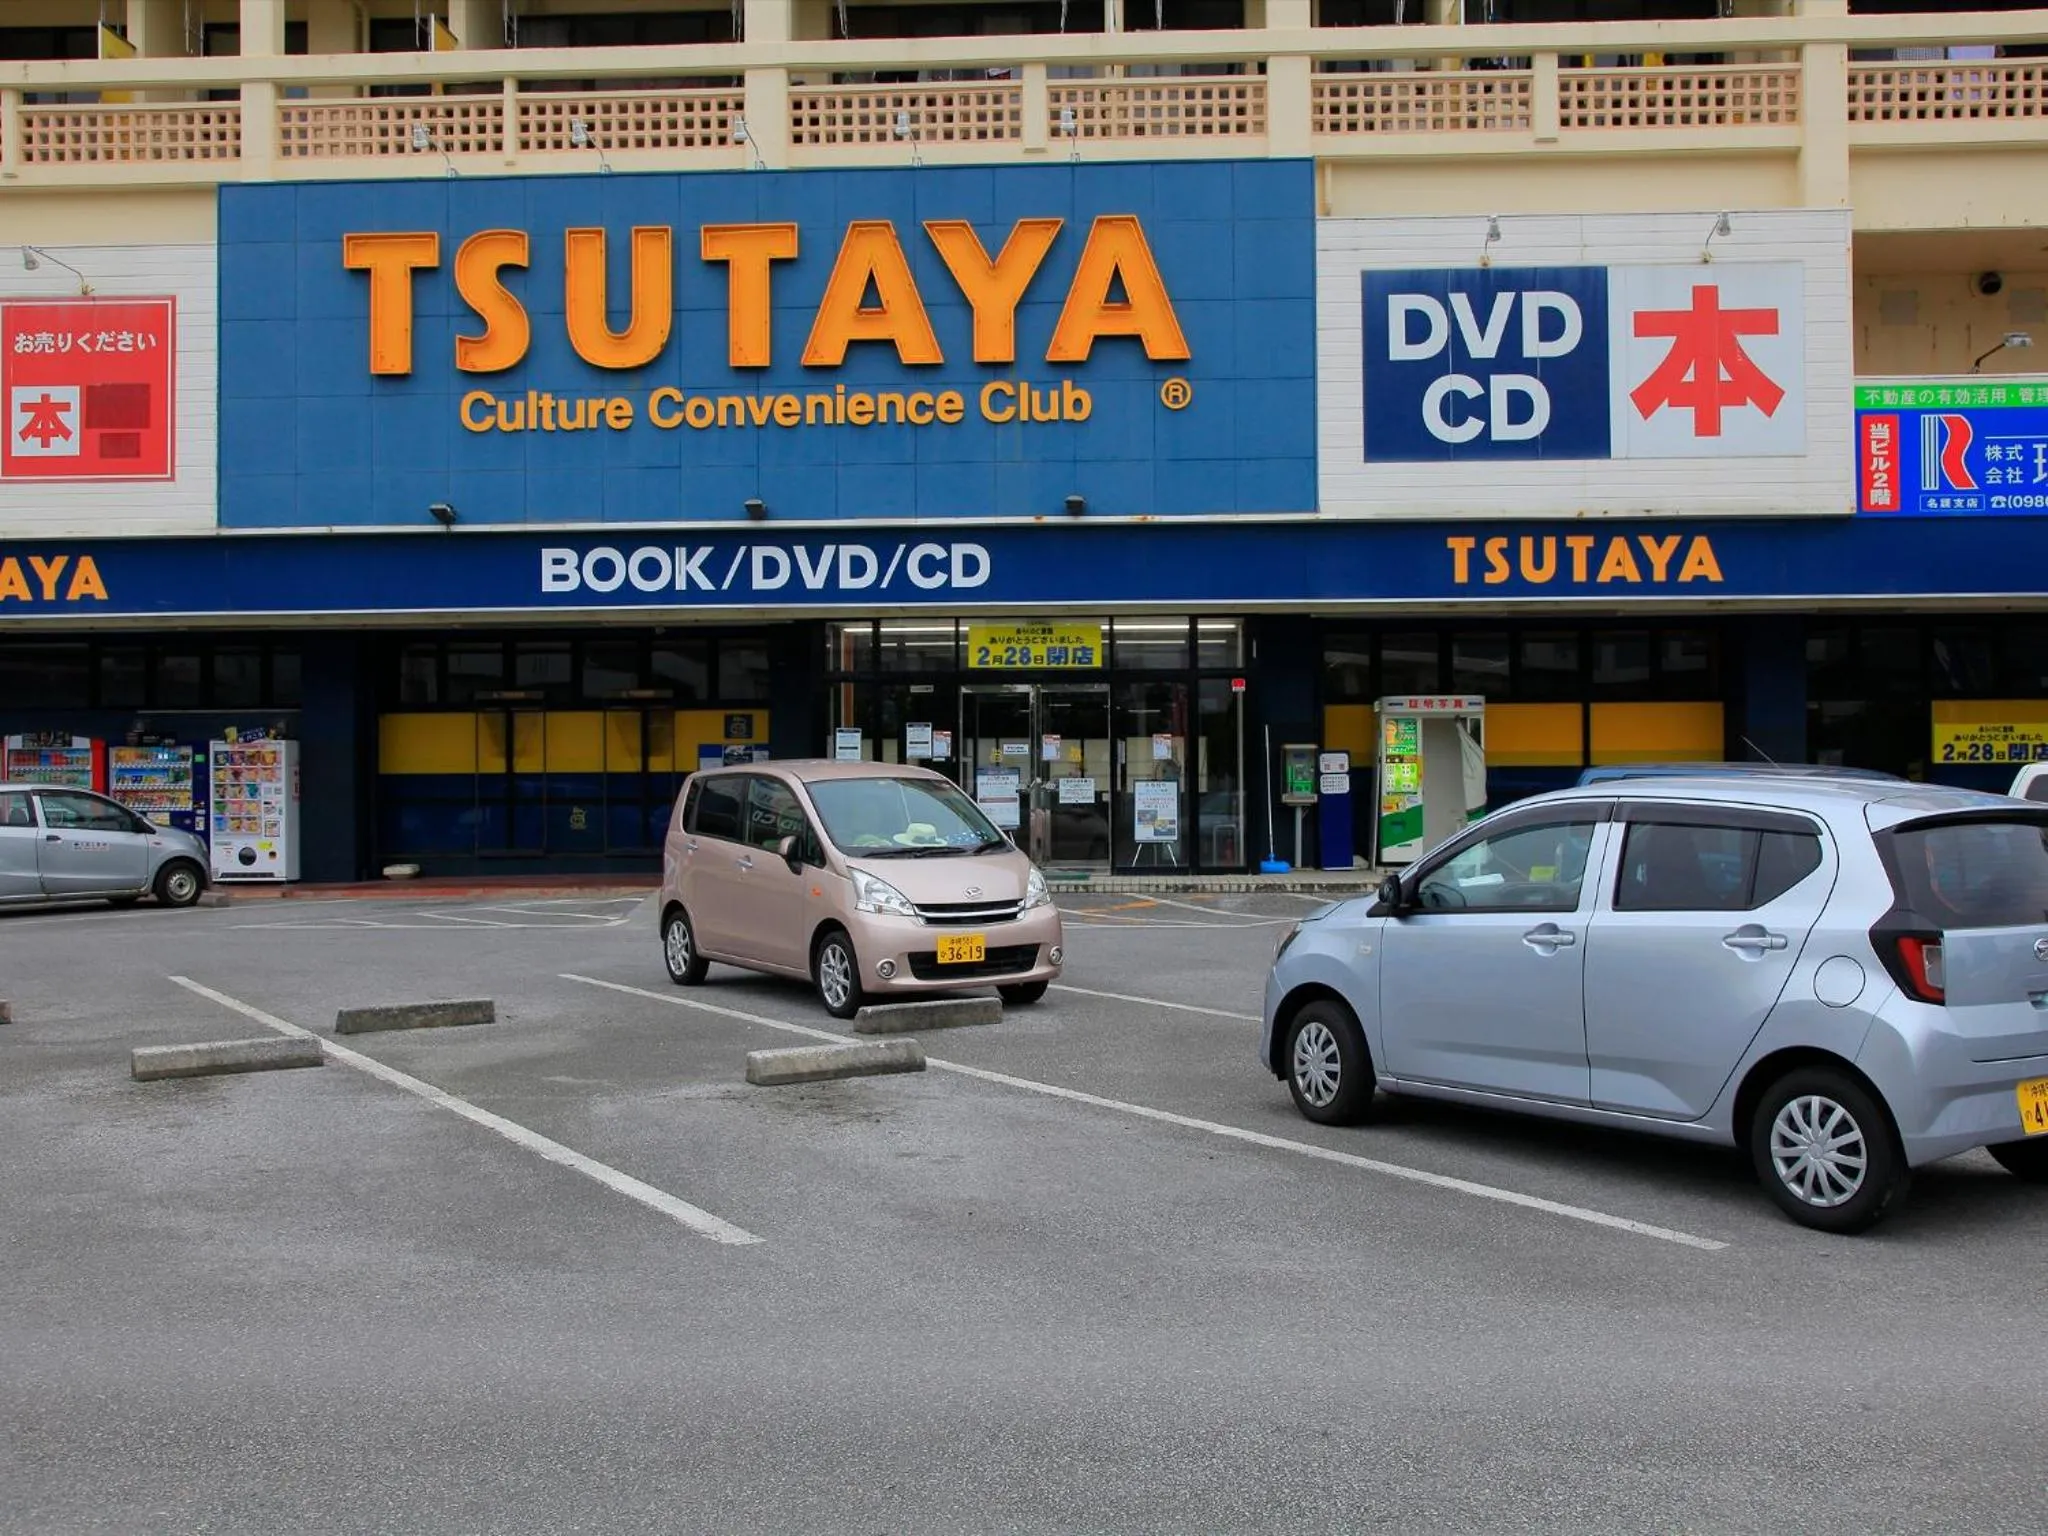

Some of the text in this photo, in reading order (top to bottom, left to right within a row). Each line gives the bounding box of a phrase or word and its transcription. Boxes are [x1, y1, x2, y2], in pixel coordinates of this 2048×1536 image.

[343, 215, 1191, 376] TSUTAYA
[14, 331, 157, 353] お売りください
[1387, 290, 1583, 361] DVD
[1630, 285, 1786, 437] 本
[18, 393, 74, 449] 本
[460, 380, 1092, 432] Culture Convenience Club
[1422, 373, 1551, 444] CD
[1869, 422, 1891, 506] 当ビル2階
[1984, 443, 2024, 462] 株式
[1984, 466, 2024, 485] 会社
[541, 543, 991, 593] BOOK/DVD/CD
[1447, 534, 1725, 584] TSUTAYA
[977, 646, 1094, 666] 2月28日閉店
